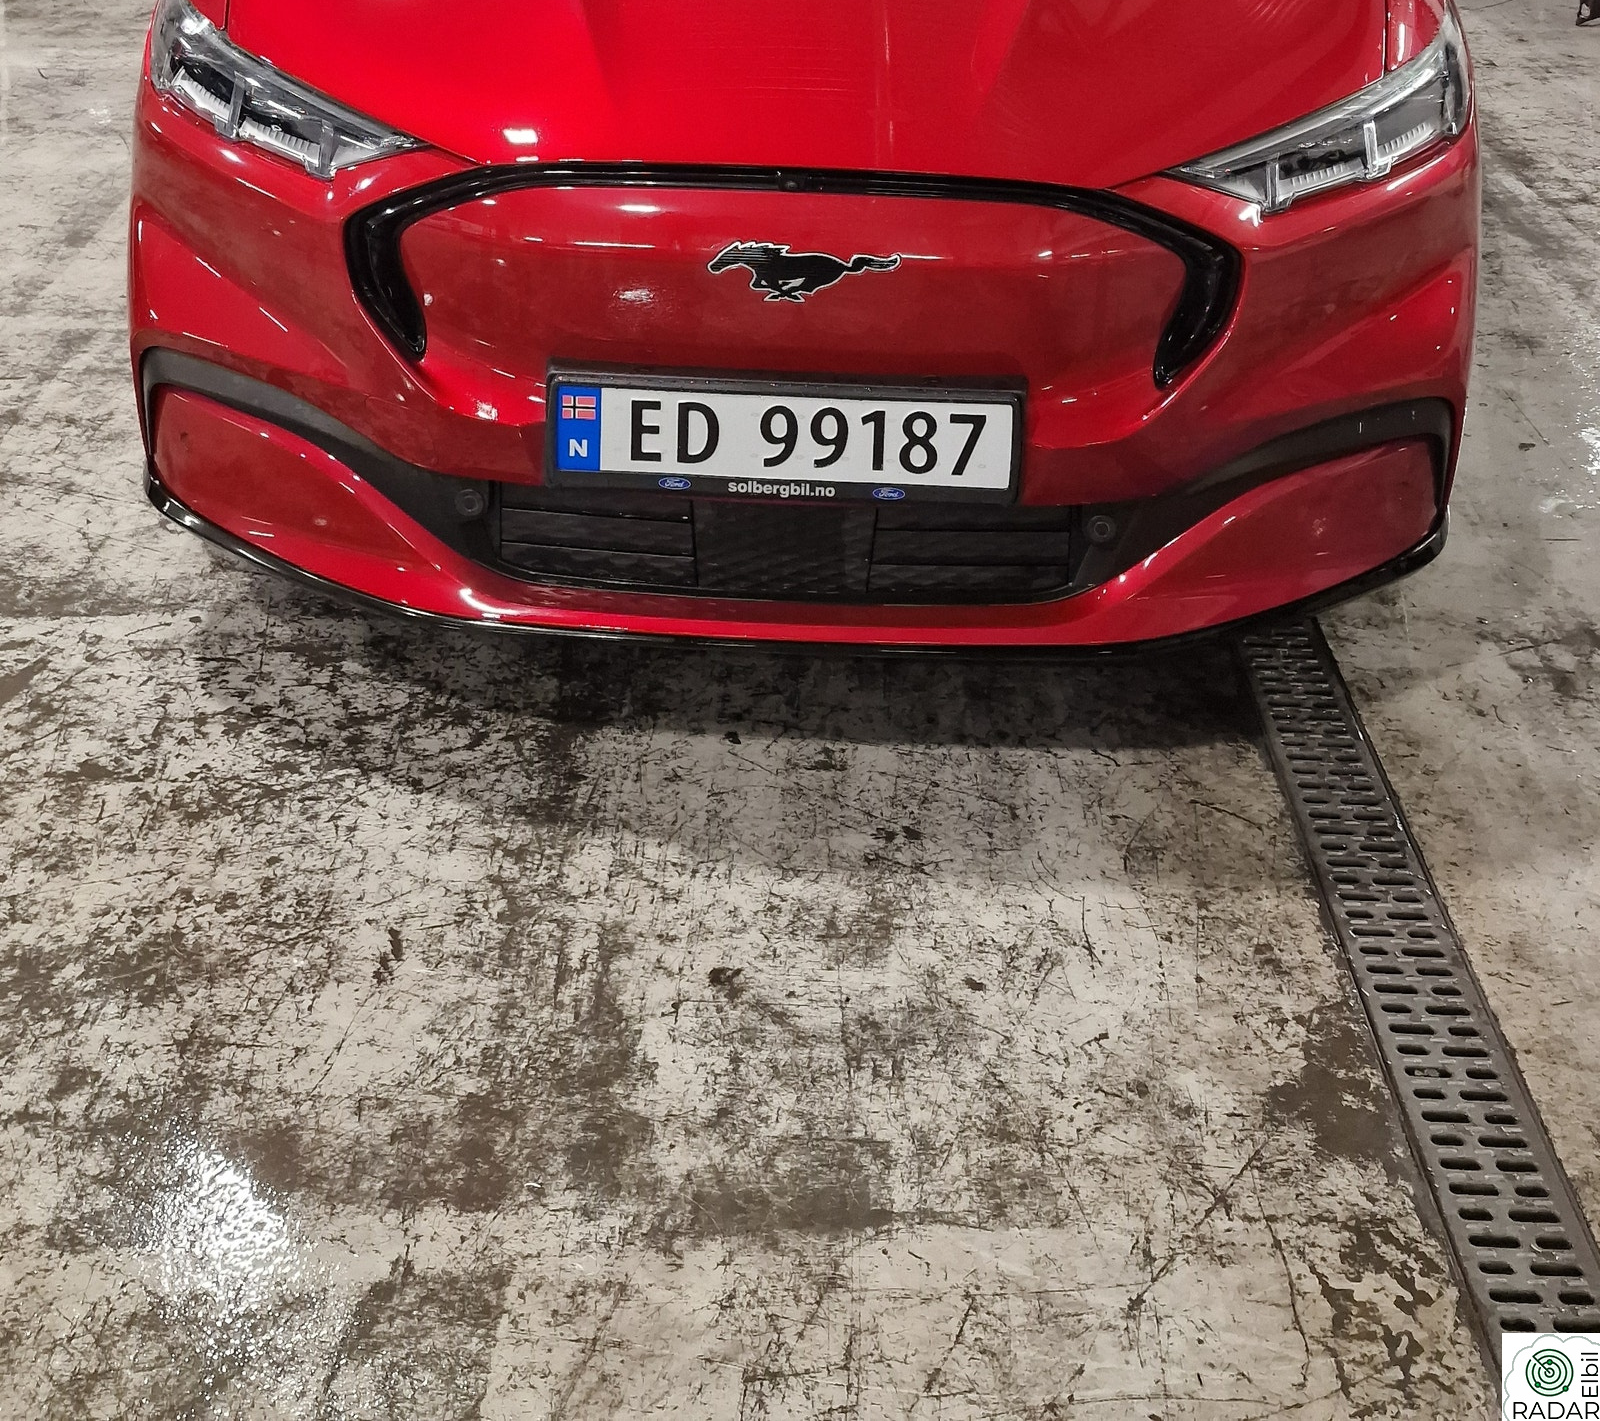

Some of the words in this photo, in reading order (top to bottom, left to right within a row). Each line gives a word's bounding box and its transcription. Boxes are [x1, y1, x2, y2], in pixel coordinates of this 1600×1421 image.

[630, 399, 720, 464] ED
[759, 404, 988, 476] 99187
[568, 438, 588, 458] N
[727, 480, 836, 498] solbergbil.no
